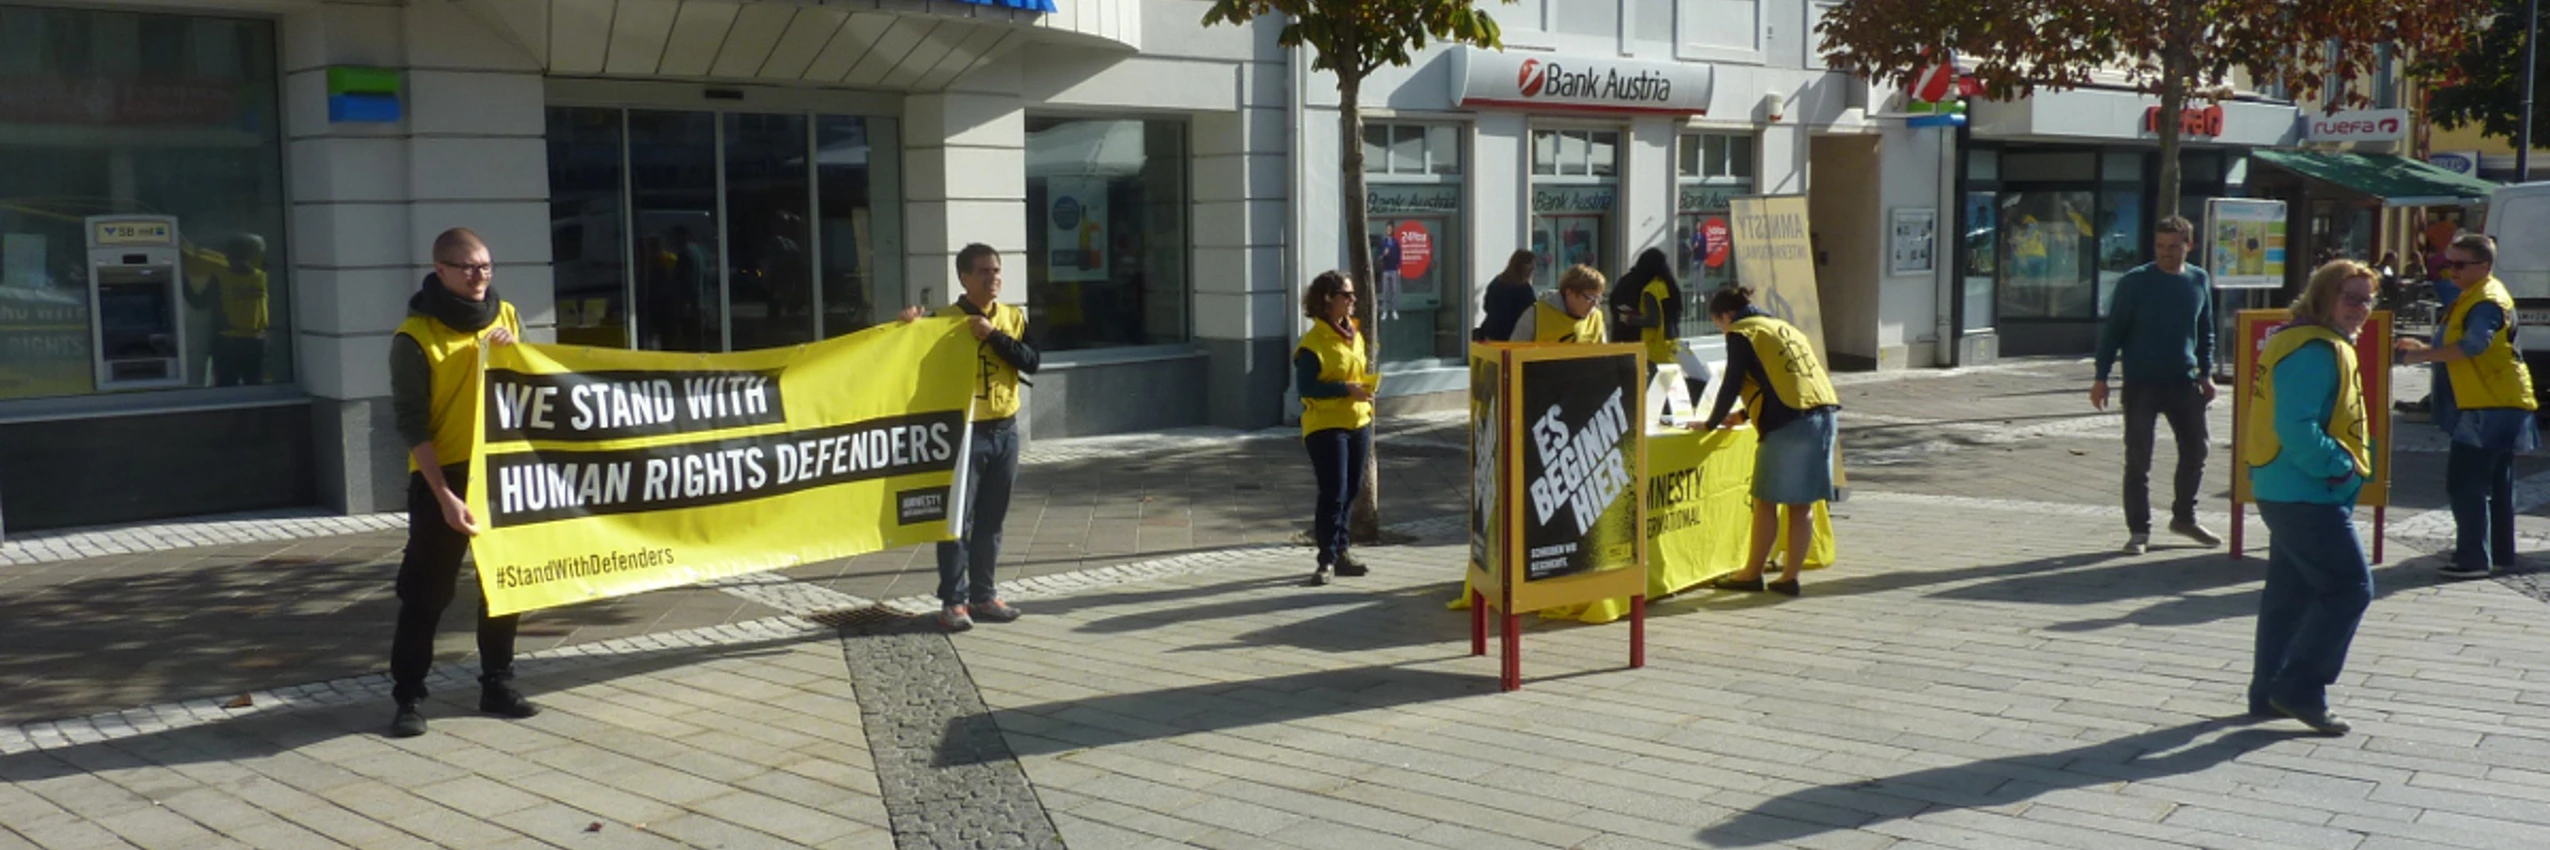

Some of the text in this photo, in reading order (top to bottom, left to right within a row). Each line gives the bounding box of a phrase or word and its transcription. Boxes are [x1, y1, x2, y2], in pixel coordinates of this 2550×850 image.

[1545, 63, 1671, 101] Bank Austria
[2313, 120, 2374, 135] ruefa
[1534, 190, 1568, 211] Bank
[495, 375, 768, 431] WE STAND WITH
[1530, 386, 1629, 526] BEGINNT
[1532, 403, 1570, 468] ES
[500, 422, 950, 514] HUMAN RIGHTS DEFENDERS
[1569, 447, 1629, 536] HIER
[1646, 465, 1704, 511] MNESTY
[496, 547, 675, 589] #StandWithDefenders
